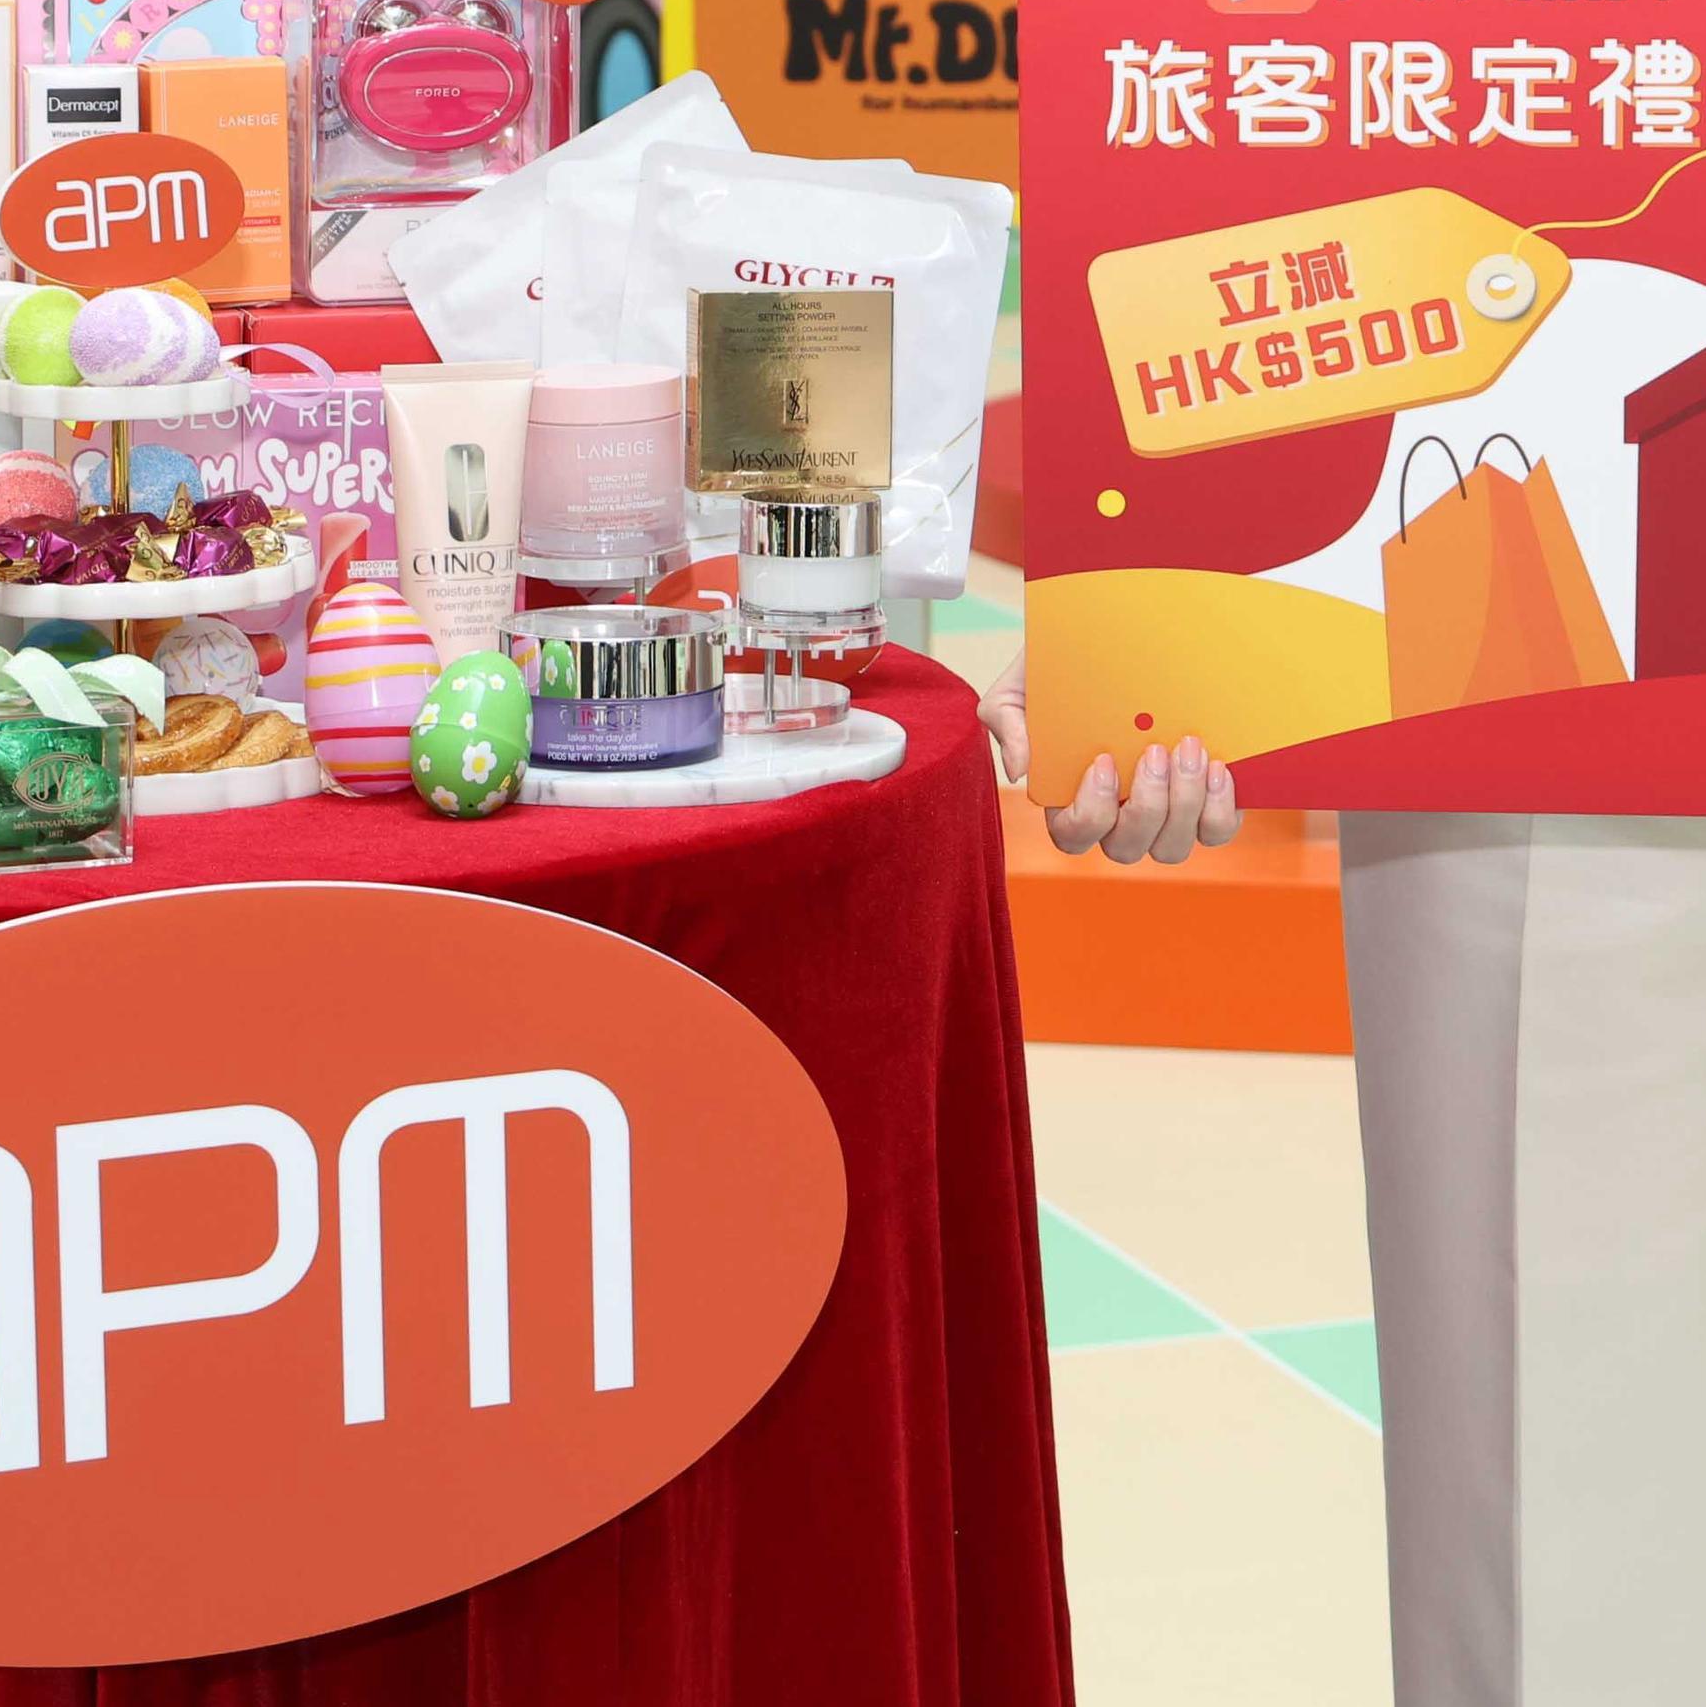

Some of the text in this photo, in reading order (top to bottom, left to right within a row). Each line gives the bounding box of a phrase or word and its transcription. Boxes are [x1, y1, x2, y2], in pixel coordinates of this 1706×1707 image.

[415, 88, 461, 97] FOREO
[48, 97, 119, 113] Dermacept
[218, 113, 279, 128] LANEIGE
[45, 170, 209, 252] apm
[1207, 239, 1355, 329] 立減
[772, 301, 822, 311] ALL HOURS
[758, 312, 836, 322] SETTING POWDER
[1135, 296, 1462, 417] HK$500
[299, 399, 385, 428] RECI
[577, 438, 654, 460] LANEIGE
[743, 475, 760, 485] Net
[427, 584, 482, 598] moisture
[567, 733, 637, 744] take the day off
[547, 752, 567, 761] POIDS
[568, 752, 581, 761] NET
[596, 753, 608, 762] 3.8
